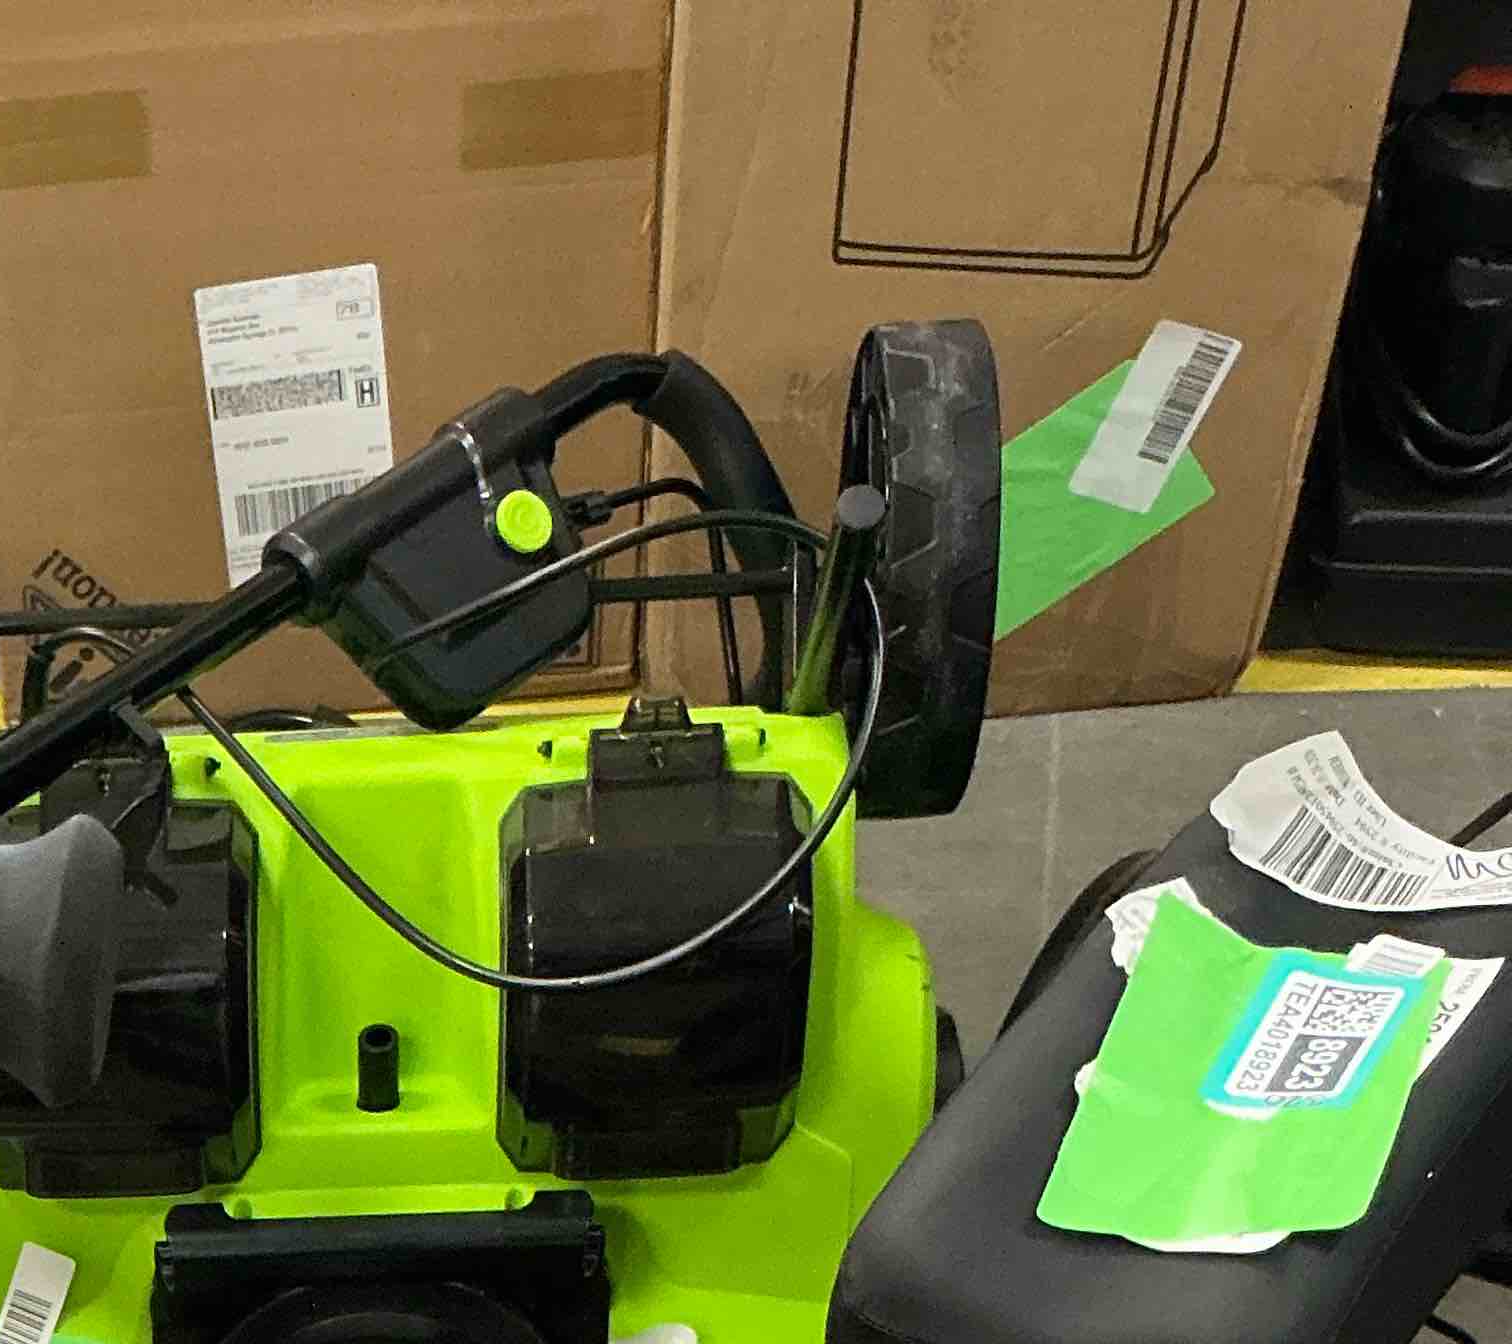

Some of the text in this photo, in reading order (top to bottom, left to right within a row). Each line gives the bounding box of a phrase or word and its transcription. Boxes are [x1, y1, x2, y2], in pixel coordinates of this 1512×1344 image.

[359, 381, 376, 405] H
[1235, 981, 1317, 1092] TEA4018923
[1285, 1038, 1348, 1091] 8923
